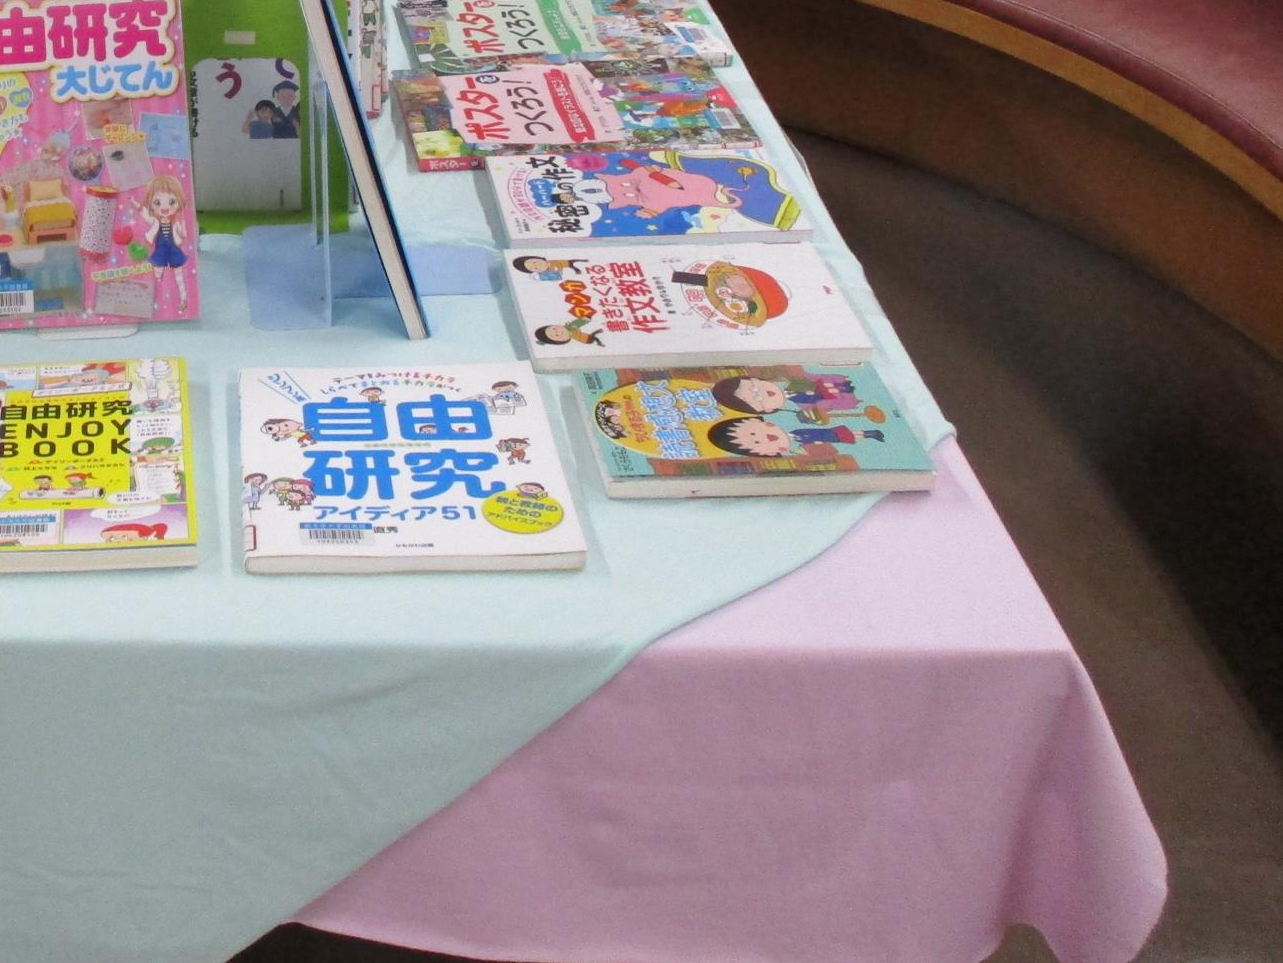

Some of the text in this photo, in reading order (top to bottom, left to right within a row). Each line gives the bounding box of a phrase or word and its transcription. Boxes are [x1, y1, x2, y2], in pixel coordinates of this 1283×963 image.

[56, 60, 172, 96] 大じてん
[502, 79, 554, 138] つくろう!
[561, 281, 594, 319] マンガ
[586, 265, 632, 334] 書きたくなる
[612, 260, 669, 335] 作文教室
[332, 371, 457, 385] テーマをみつけるチカラ
[0, 399, 132, 421] 自由研究
[302, 394, 493, 441] 自由
[302, 448, 507, 500] 研究
[313, 504, 476, 522] アイディア51
[504, 506, 542, 518] ための
